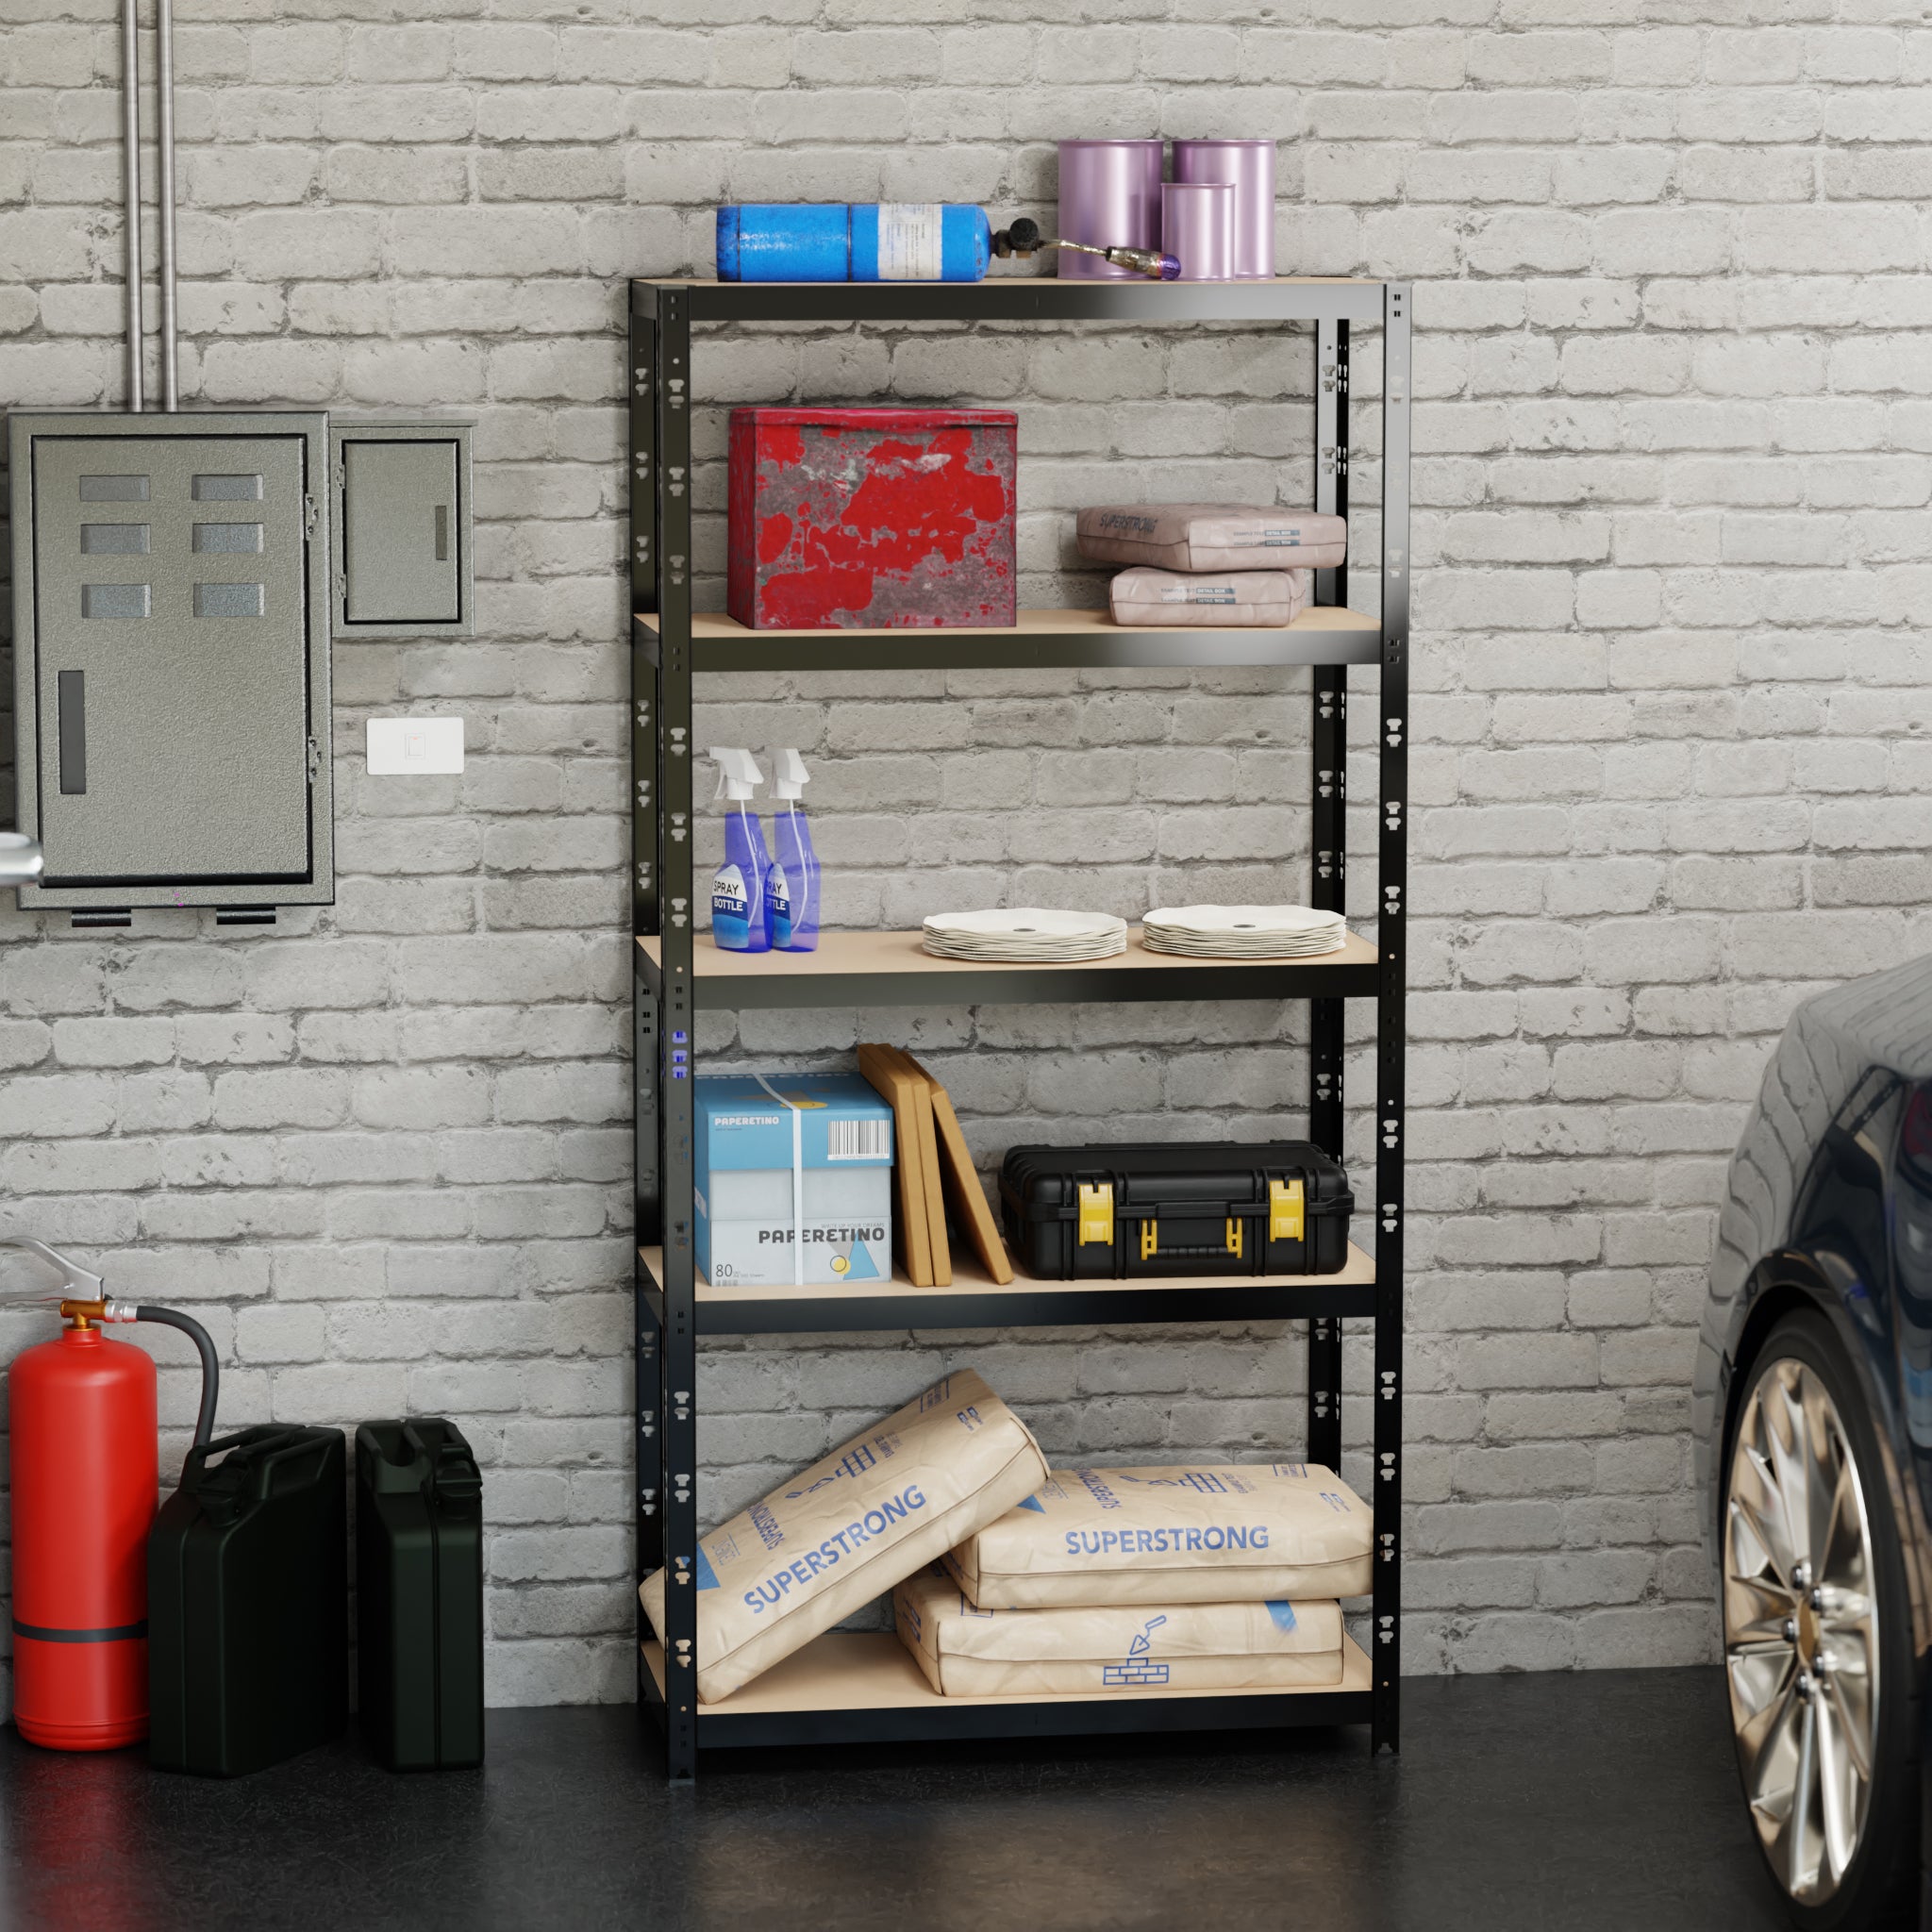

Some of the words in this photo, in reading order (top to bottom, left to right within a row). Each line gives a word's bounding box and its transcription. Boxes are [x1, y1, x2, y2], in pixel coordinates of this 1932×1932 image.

[1099, 513, 1158, 533] SUPERSTRONG
[713, 880, 740, 895] SPRAY
[713, 896, 743, 911] BOTTLE
[714, 1116, 779, 1126] PAPERETINO
[758, 1227, 885, 1243] PAPERETINO
[716, 1264, 733, 1277] 80
[1065, 1525, 1269, 1555] SUPERSTRONG
[744, 1485, 926, 1613] SUPERSTRONG
